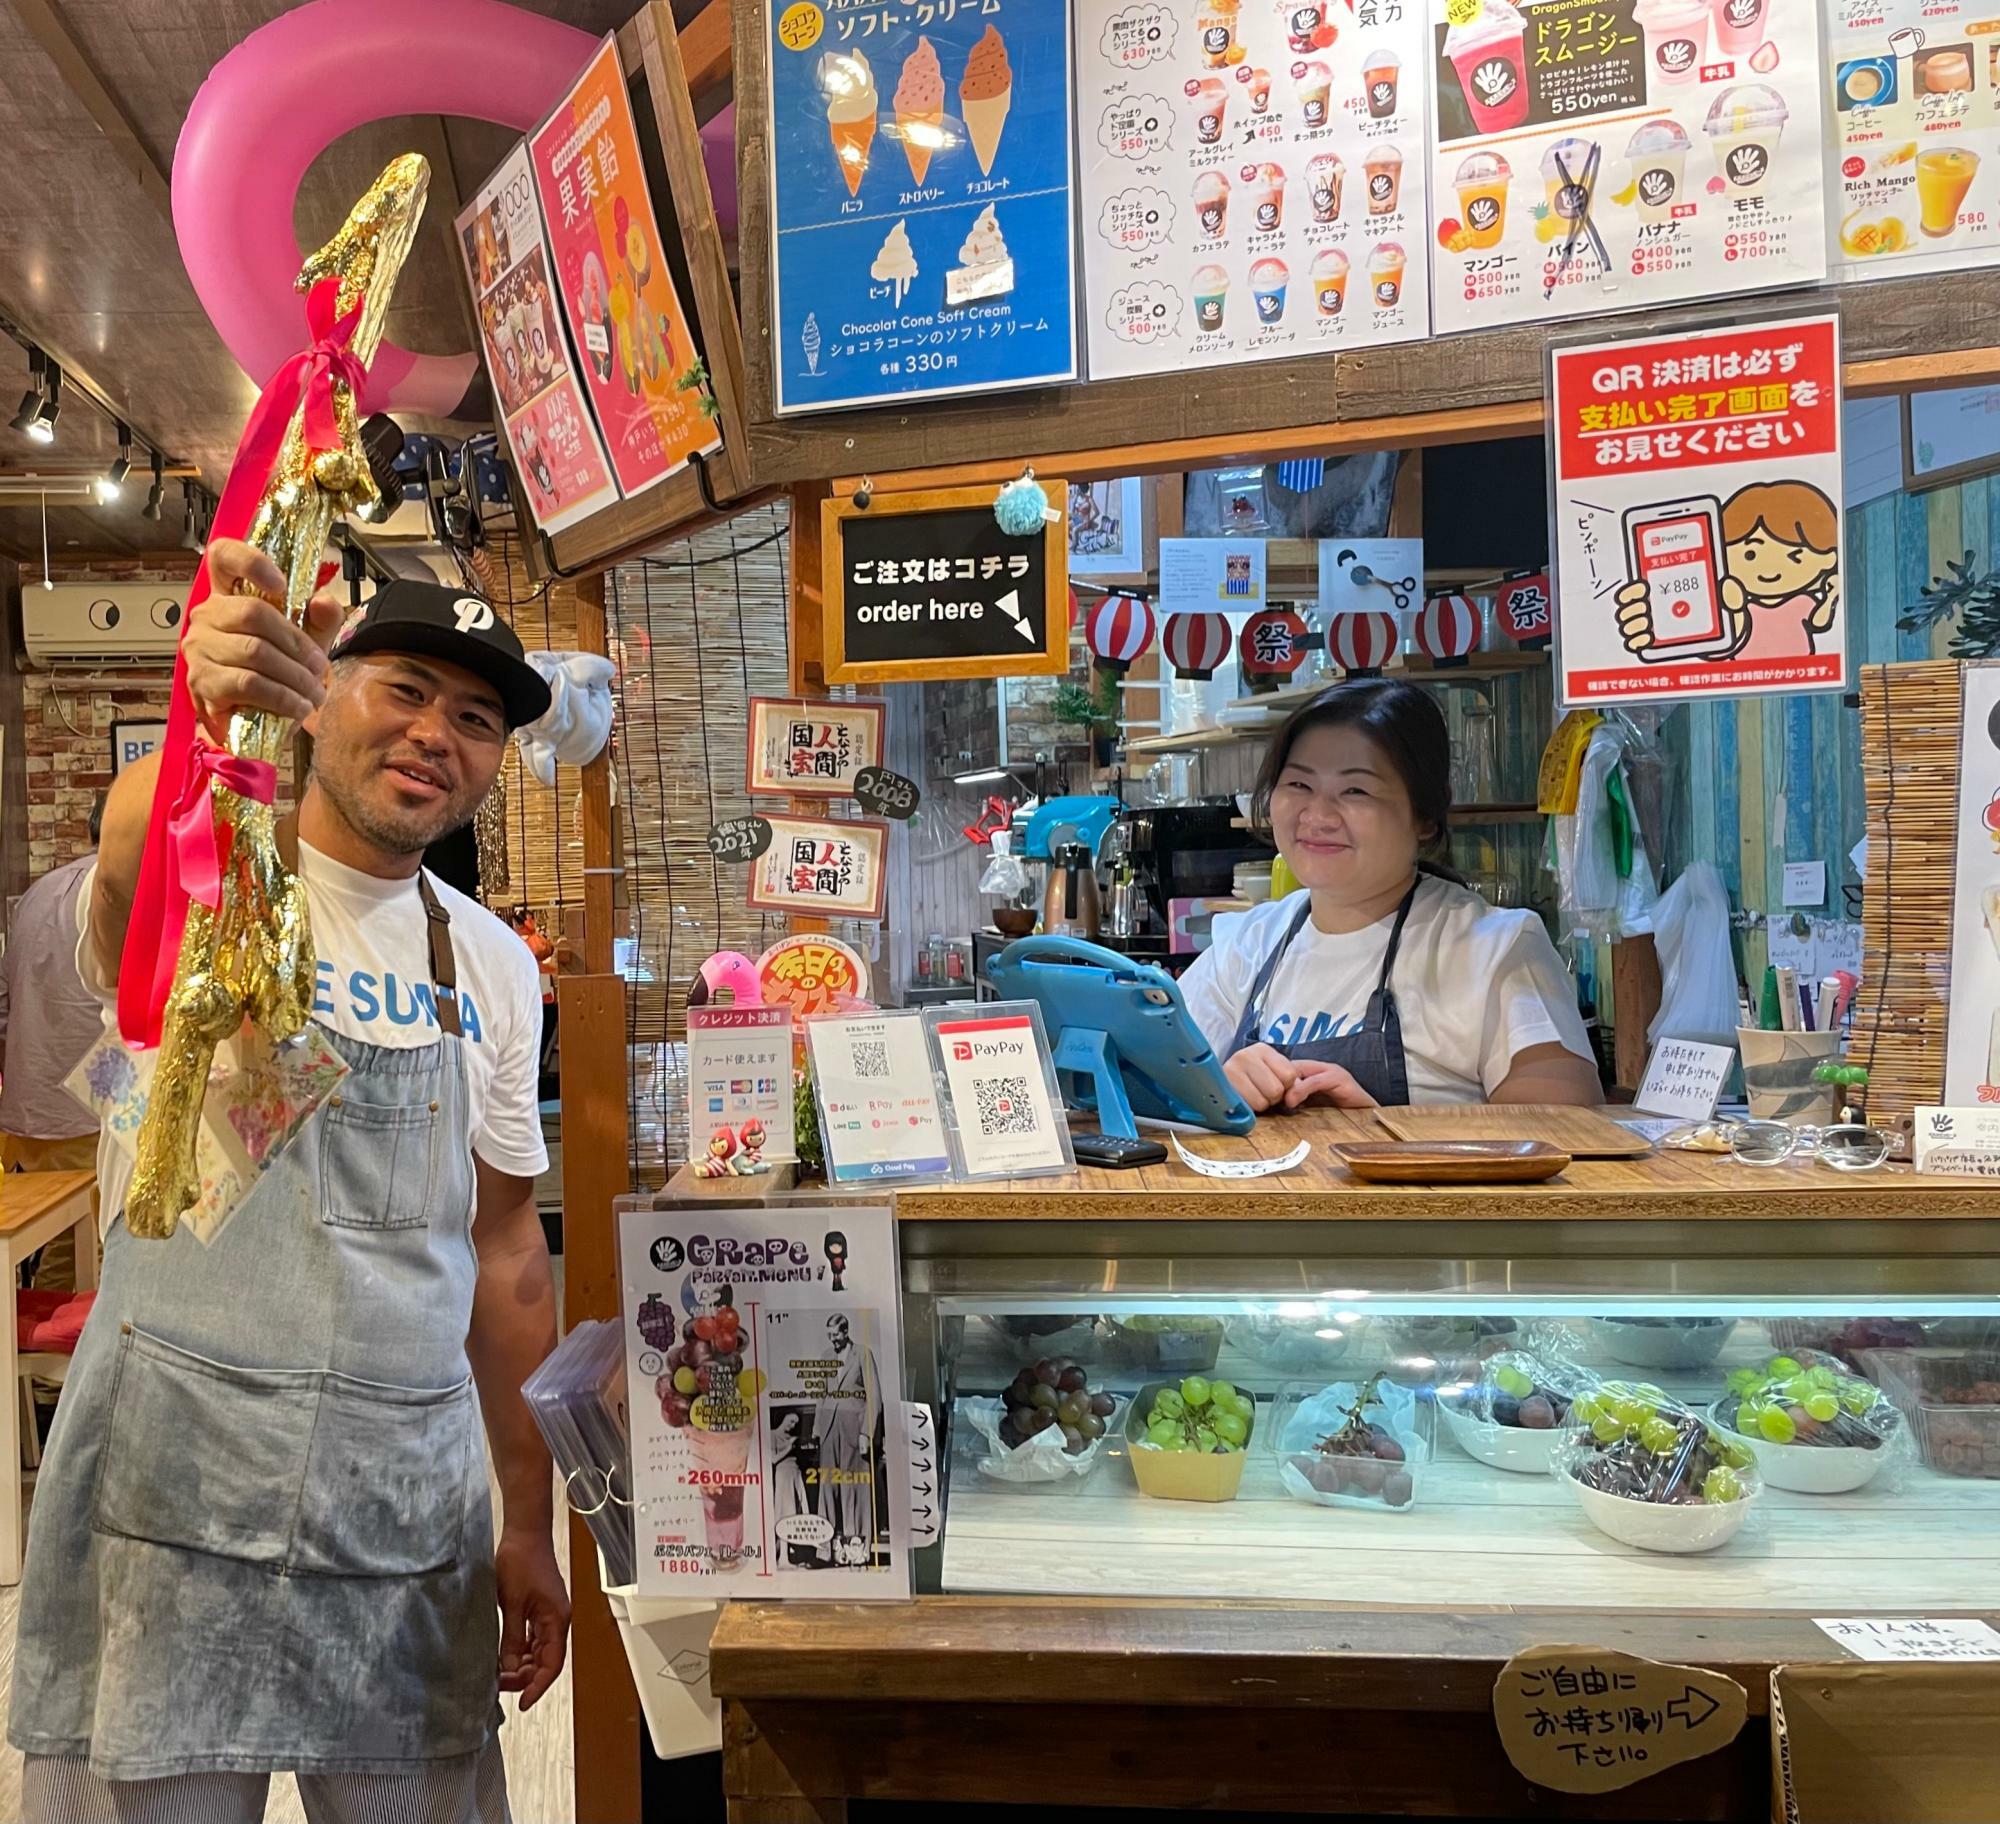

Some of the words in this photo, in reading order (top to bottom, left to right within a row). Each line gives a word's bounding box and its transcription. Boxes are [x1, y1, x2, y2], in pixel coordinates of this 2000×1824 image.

[1448, 0, 1477, 20] NEW
[1921, 6, 1958, 17] 420yen
[781, 8, 817, 34] ショコラ
[1537, 11, 1615, 44] ドラゴン
[788, 25, 816, 46] コーン
[1123, 47, 1145, 61] 630
[1534, 32, 1637, 67] スムージー
[1704, 65, 1731, 80] 牛乳
[1344, 97, 1365, 109] 450
[1551, 92, 1617, 114] 550yen
[1259, 126, 1280, 138] 450
[1847, 119, 1881, 131] コーヒー
[1120, 137, 1143, 151] 550
[1188, 143, 1234, 158] アールグレイ
[1189, 156, 1235, 168] ミルクティー
[559, 130, 619, 229] 果実飴
[967, 178, 1010, 195] チョコレート
[1845, 181, 1870, 192] Rich
[1877, 176, 1915, 188] Mango
[899, 188, 945, 205] ストロベリー
[1733, 196, 1764, 211] モモ
[841, 201, 864, 213] バニラ
[1112, 202, 1143, 213] ちょっと
[1112, 211, 1143, 223] リッチな
[1364, 215, 1405, 227] キャラメル
[1958, 212, 1985, 225] 580
[1121, 230, 1144, 242] 550
[1304, 223, 1350, 236] チョコレート
[1364, 225, 1405, 237] マキアート
[1638, 221, 1681, 238] バナナ
[1248, 232, 1286, 244] キャラメル
[1740, 231, 1767, 245] 550
[1192, 241, 1230, 253] カフェラテ
[1646, 245, 1673, 259] 400
[1740, 246, 1767, 259] 700
[1464, 255, 1517, 272] マンゴー
[1647, 259, 1673, 272] 550
[1478, 271, 1502, 284] 500
[1558, 273, 1583, 286] 650
[870, 286, 892, 299] ピーチ
[1478, 285, 1502, 298] 650
[1118, 295, 1150, 306] ジュース
[841, 318, 897, 337] Chocolat
[901, 314, 934, 331] Cone
[937, 309, 965, 326] Soft
[969, 303, 1011, 321] Cream
[1316, 317, 1347, 326] マンゴー
[1373, 310, 1404, 319] マンゴー
[1128, 323, 1151, 335] 500
[1373, 319, 1404, 329] ジュース
[830, 318, 1049, 357] ショコラコーンのソフトクリーム
[1196, 333, 1226, 343] クリーム
[1249, 334, 1295, 346] レモンソーダ
[905, 354, 942, 373] 330
[946, 355, 958, 368] 円
[1592, 364, 1643, 393] QR
[1652, 343, 1804, 388] 決済は必ず
[1579, 380, 1819, 432] 支払い完了画面を
[1596, 421, 1805, 465] お見せください
[1577, 513, 1603, 590] ピンポーン
[1651, 551, 1696, 568] 支払い完了
[853, 554, 1030, 585] ご注文はコチラ
[857, 600, 923, 623] order
[929, 598, 984, 620] here
[1509, 590, 1547, 630] 祭
[1255, 623, 1291, 663] 祭
[814, 725, 838, 778] 人間
[858, 773, 912, 808] 2008
[710, 829, 758, 853] 2021
[816, 842, 839, 895] 人間
[699, 1011, 780, 1026] クレジット決済
[974, 1041, 1024, 1057] PayPay
[704, 1053, 777, 1066] カード使えます
[688, 1471, 759, 1485] 260mm
[806, 1468, 870, 1484] 272cm
[660, 1561, 699, 1573] 1880
[1520, 1666, 1637, 1698] ご自由に
[1525, 1706, 1664, 1736] お持ち帰り
[1557, 1743, 1648, 1767] 下さい。
